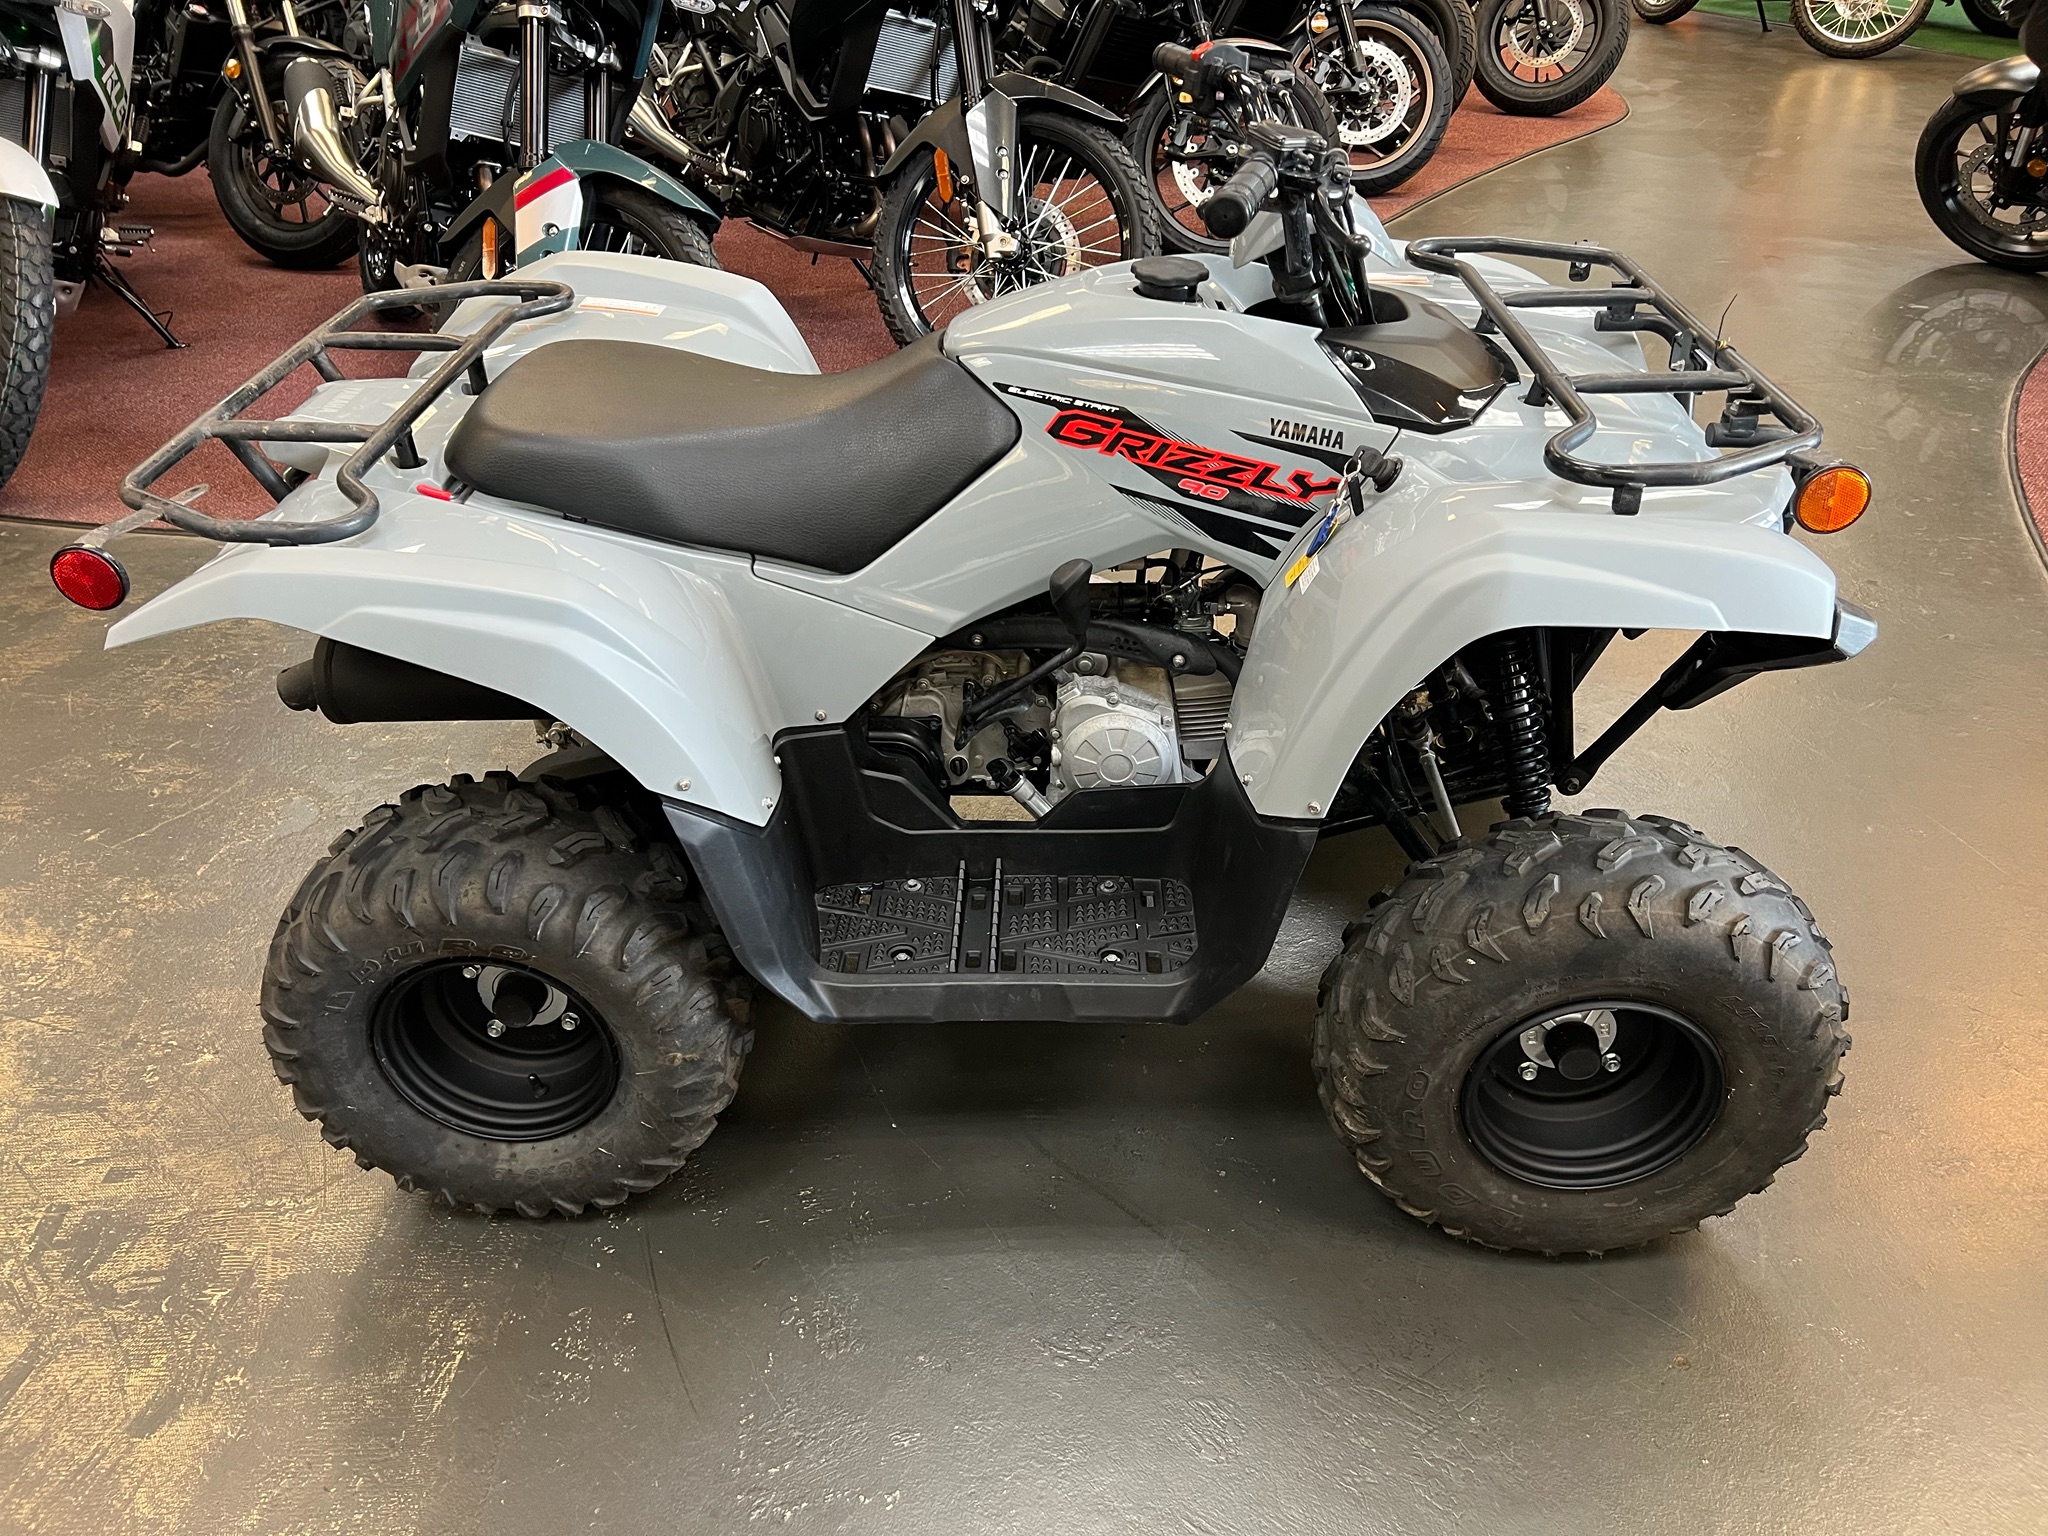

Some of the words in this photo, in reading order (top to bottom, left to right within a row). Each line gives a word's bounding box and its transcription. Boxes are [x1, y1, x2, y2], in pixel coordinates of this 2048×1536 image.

[1008, 386, 1073, 404] ELECTRIC
[1074, 399, 1119, 413] START
[1269, 417, 1344, 450] YAMAHA
[1045, 409, 1344, 504] GRIZZLY
[1178, 478, 1230, 501] 90
